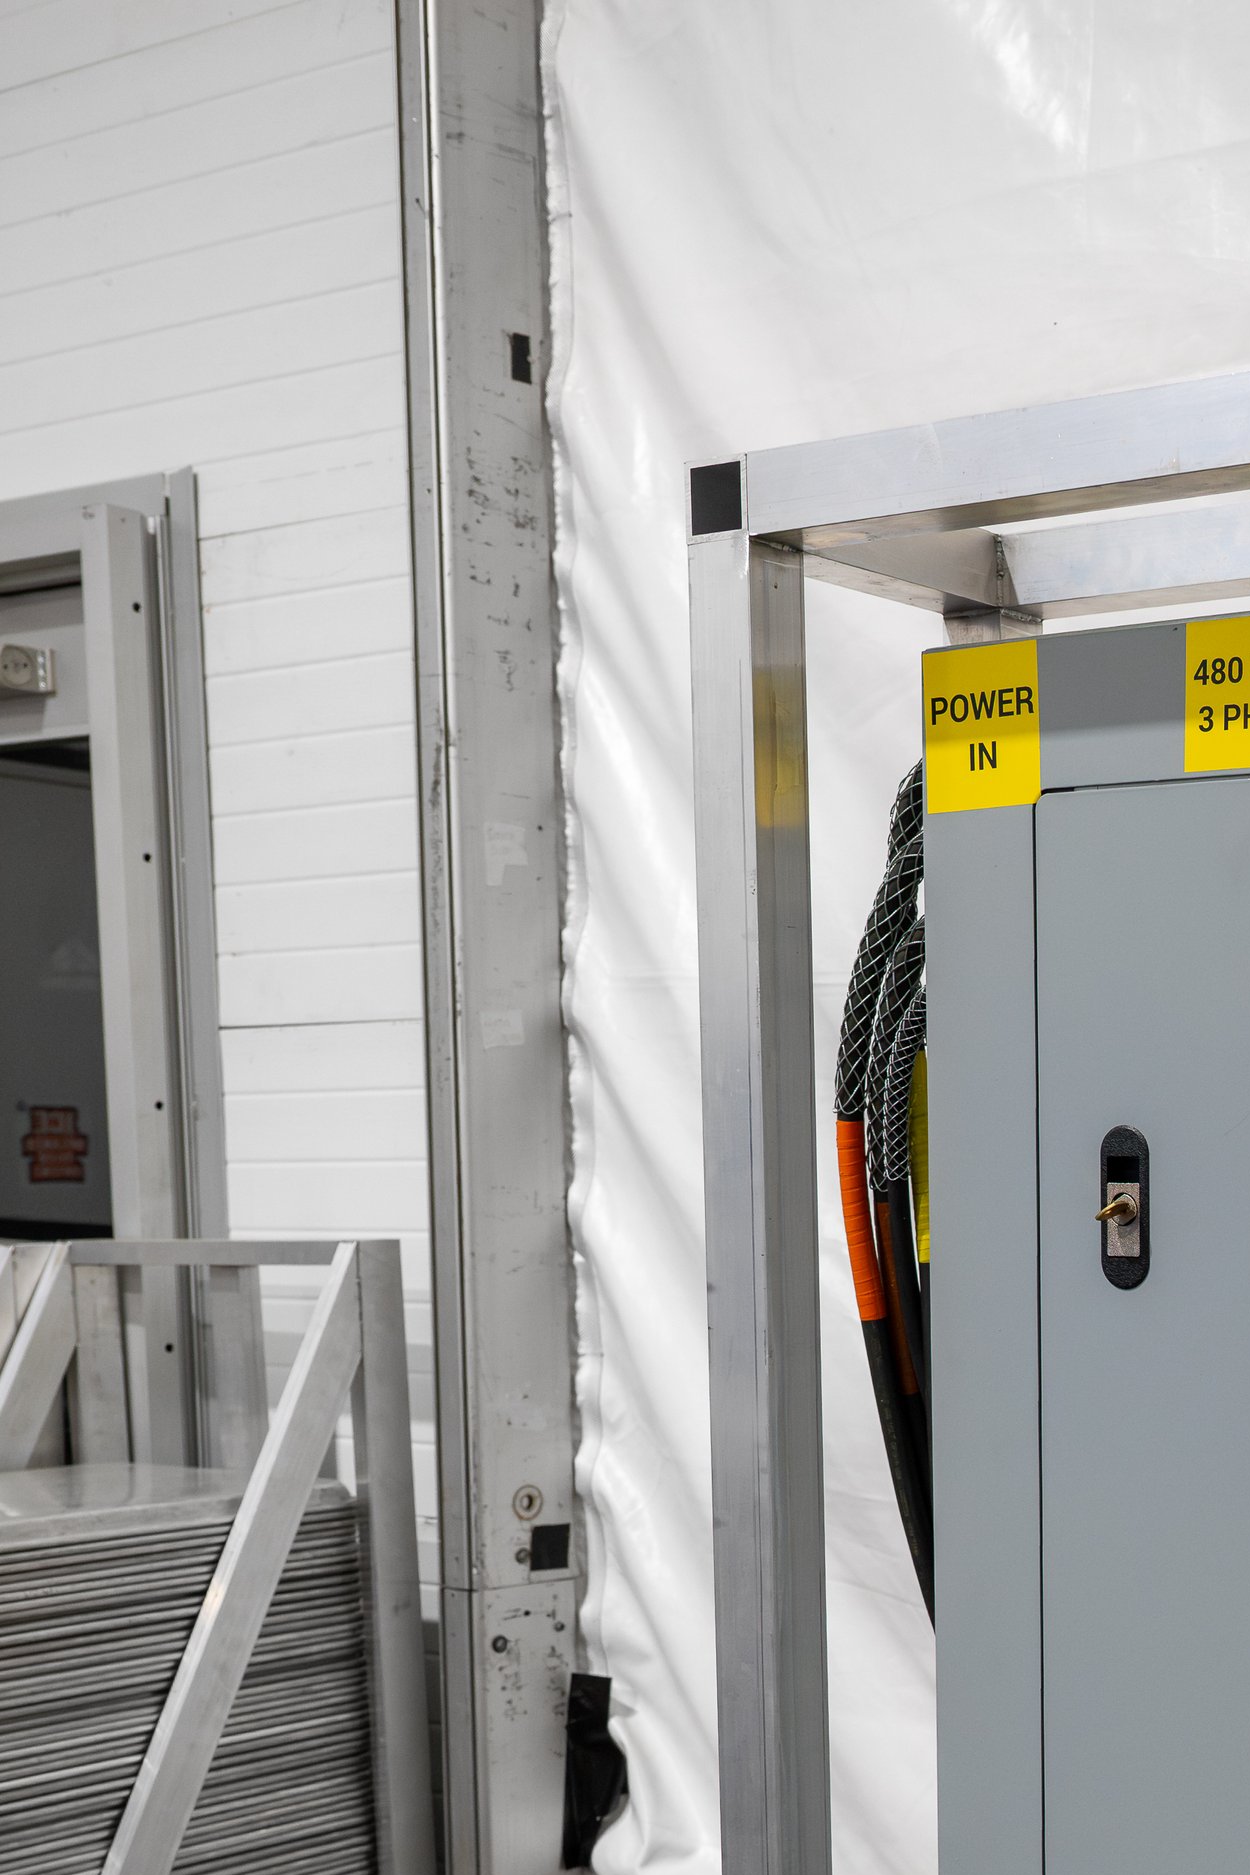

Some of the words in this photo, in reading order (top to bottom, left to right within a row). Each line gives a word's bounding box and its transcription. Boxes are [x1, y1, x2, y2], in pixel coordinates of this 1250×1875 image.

[1193, 656, 1244, 687] 480
[930, 685, 1035, 726] POWER
[1198, 704, 1215, 733] 3
[969, 740, 998, 772] IN
